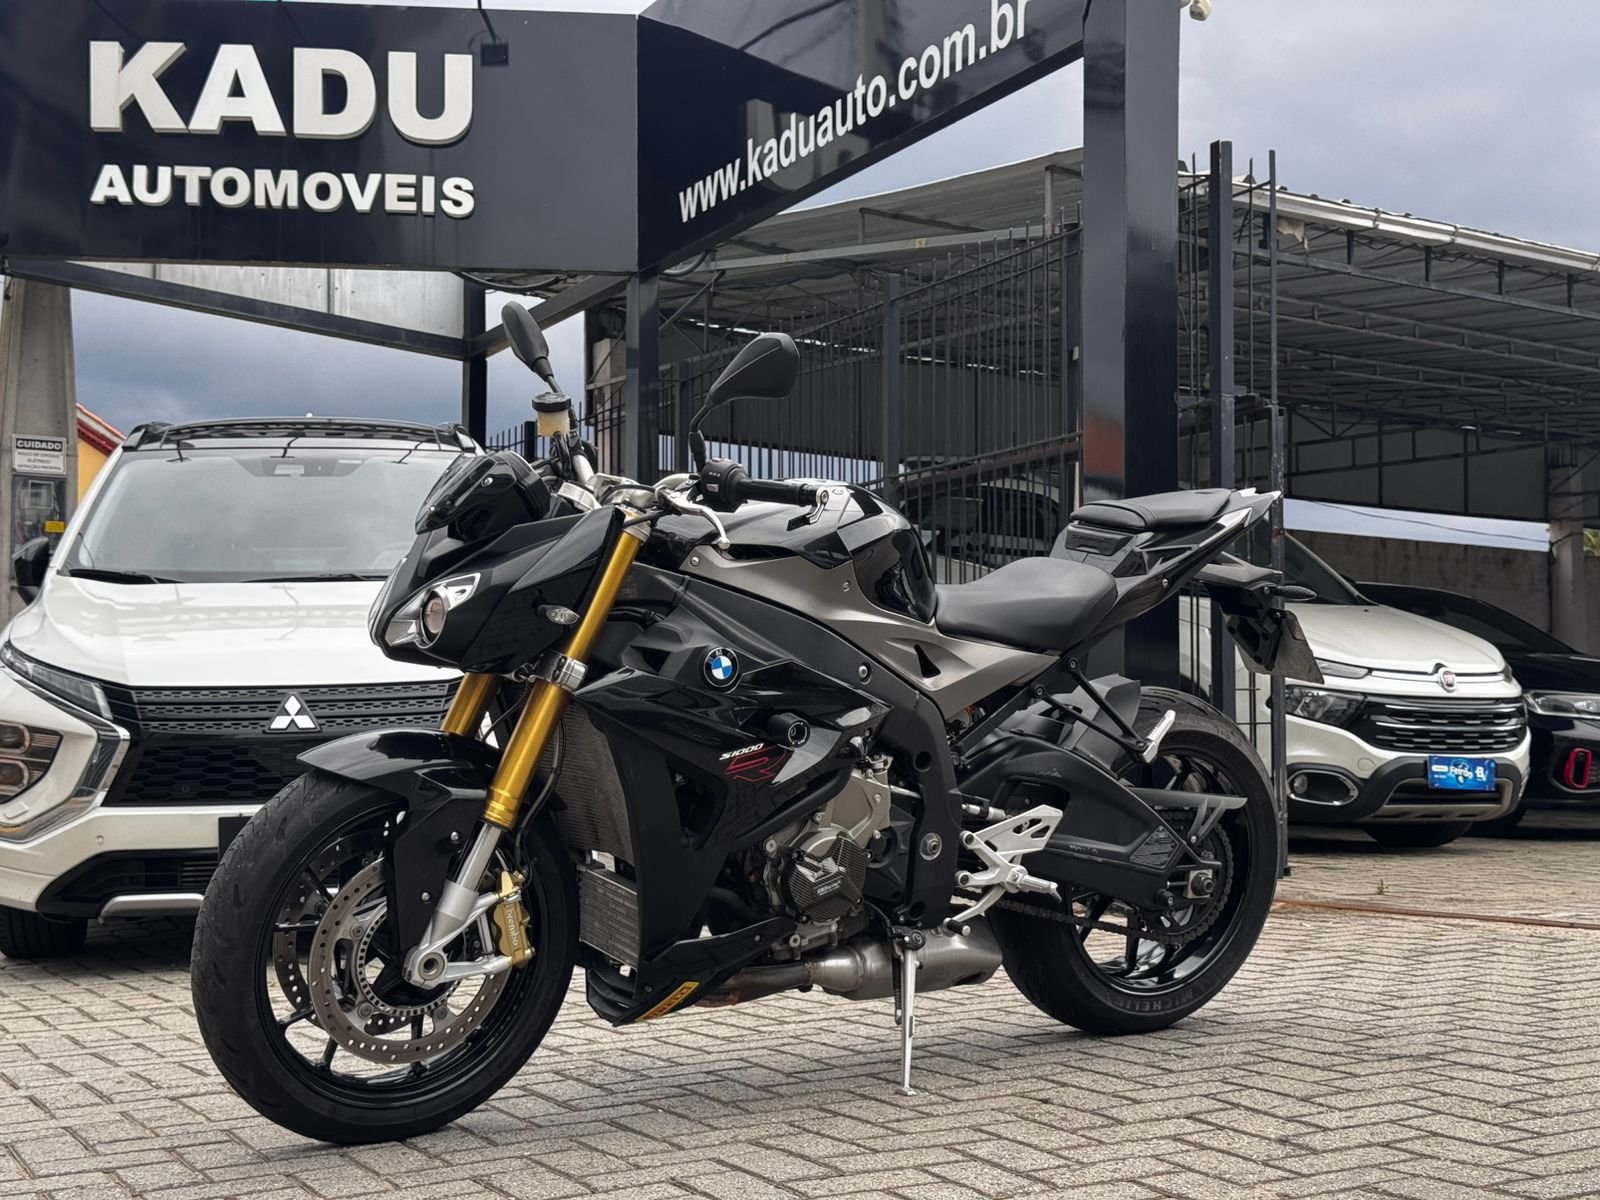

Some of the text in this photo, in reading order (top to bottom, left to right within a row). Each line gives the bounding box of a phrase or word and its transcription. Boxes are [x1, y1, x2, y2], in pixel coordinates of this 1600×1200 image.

[89, 40, 473, 145] KADU
[679, 0, 1032, 223] www.kaduauto.com.br
[90, 164, 475, 219] AUTOMOVEIS
[17, 440, 61, 449] CUIDADO
[719, 742, 764, 760] S1000
